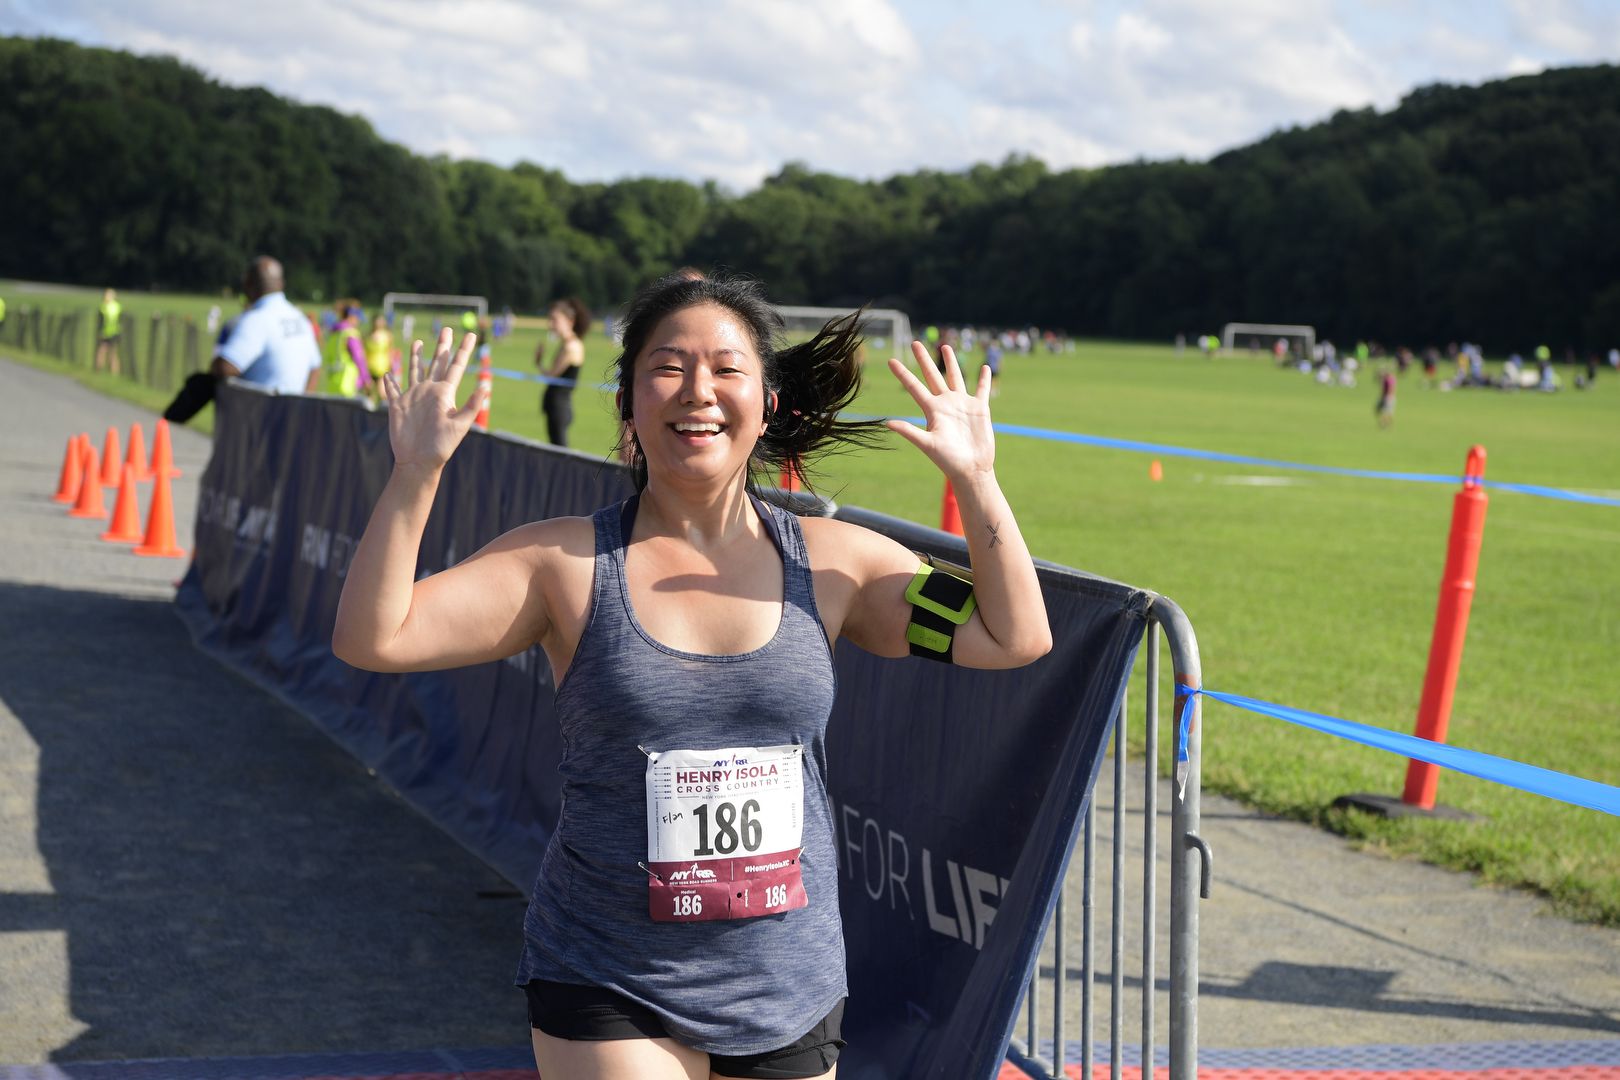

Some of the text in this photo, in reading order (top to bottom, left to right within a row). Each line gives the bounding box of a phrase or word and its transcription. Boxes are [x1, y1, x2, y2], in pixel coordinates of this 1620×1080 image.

[676, 769, 732, 784] HENRY
[736, 764, 778, 780] ISOLA
[676, 778, 779, 794] CROSS COUNTRY
[693, 799, 762, 857] 186
[842, 803, 915, 921] FOR
[669, 868, 717, 881] NYRR
[672, 894, 703, 916] 186
[765, 883, 787, 909] 186
[922, 847, 1011, 951] LIF
